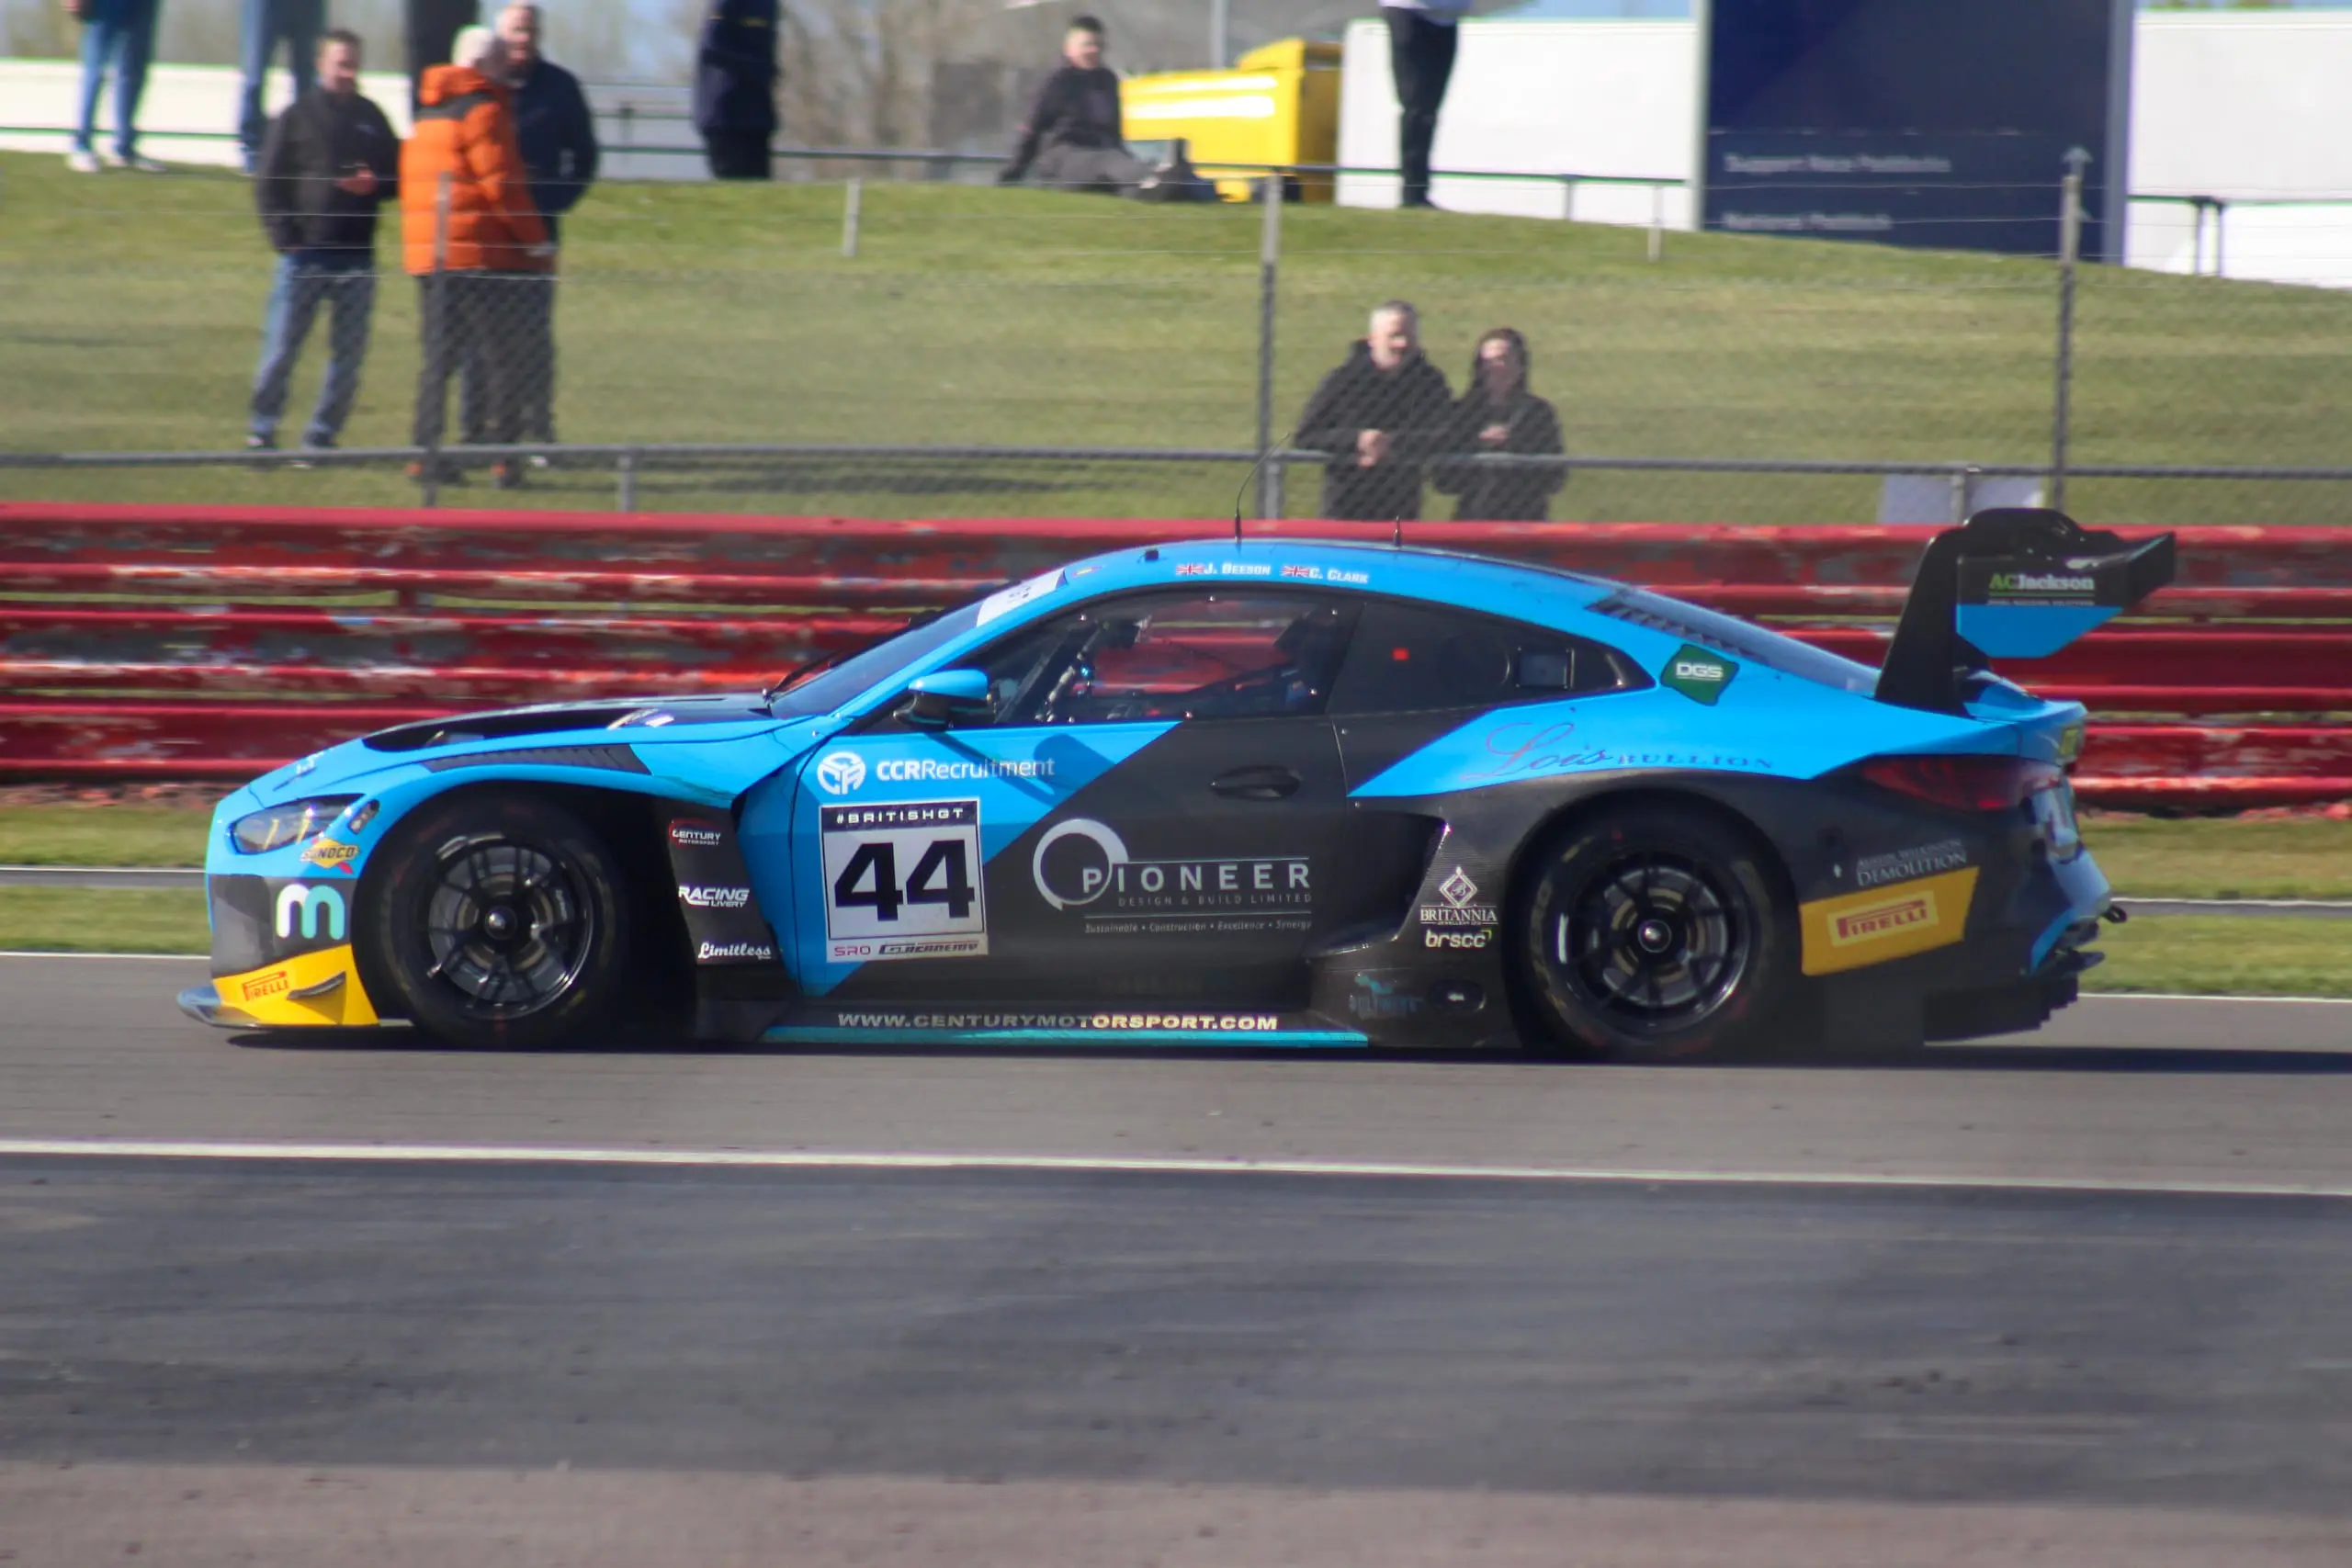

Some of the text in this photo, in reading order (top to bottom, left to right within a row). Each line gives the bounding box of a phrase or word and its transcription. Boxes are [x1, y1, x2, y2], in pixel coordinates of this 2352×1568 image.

[1204, 562, 1217, 575] J.
[1676, 661, 1724, 678] DGS
[876, 757, 1056, 781] CCRRecruitment
[836, 807, 965, 825] #BRITISHGT
[672, 829, 721, 841] CENTURY
[301, 845, 357, 862] SUNOCO
[1856, 852, 1968, 886] DEMOLITION
[833, 839, 976, 921] 44
[1082, 863, 1311, 894] PIONEER
[678, 885, 750, 906] RACING
[710, 899, 746, 908] LIVERY
[1118, 895, 1173, 908] DESIGN
[1198, 894, 1242, 906] BUILD
[1250, 893, 1312, 905] LIMITED
[1420, 908, 1498, 921] BRITANNIA
[1836, 899, 1928, 940] PIRELLI
[1425, 929, 1486, 948] brscc
[697, 941, 772, 959] Limitless
[833, 945, 871, 957] SRO
[243, 970, 289, 1001] PIRELLI
[837, 1012, 1278, 1031] WWW.CENTURYMOTORSPORT.COM
